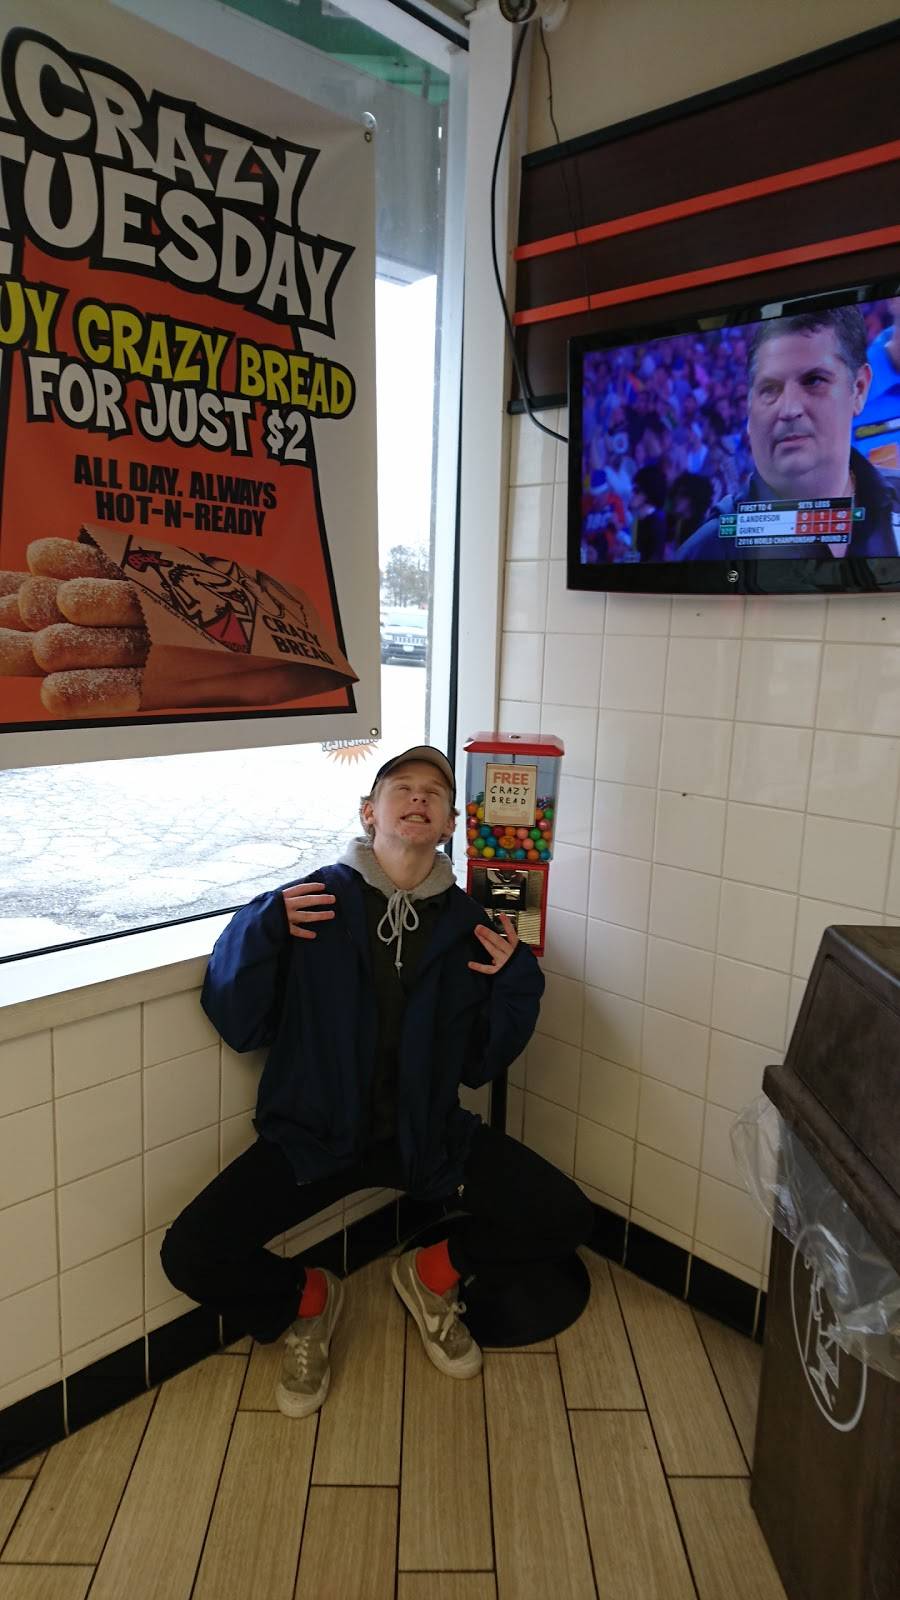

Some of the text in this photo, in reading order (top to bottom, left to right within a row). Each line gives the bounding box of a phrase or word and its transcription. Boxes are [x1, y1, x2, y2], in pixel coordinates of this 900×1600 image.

[12, 34, 309, 229] CRAZY
[76, 302, 230, 391] CRAZY
[238, 342, 354, 416] BREAD
[27, 355, 308, 463] FOR JUST $2
[74, 454, 278, 510] ALL DAY. ALWAYS
[95, 490, 266, 537] HOT-N-READY
[740, 504, 757, 513] FIRST
[758, 503, 767, 511] TO
[739, 526, 765, 535] GURNEY
[262, 614, 322, 648] CRAZY
[270, 633, 335, 665] BREAD
[490, 785, 530, 796] CRAZY
[493, 771, 529, 785] FREE
[491, 796, 527, 805] BREAD
